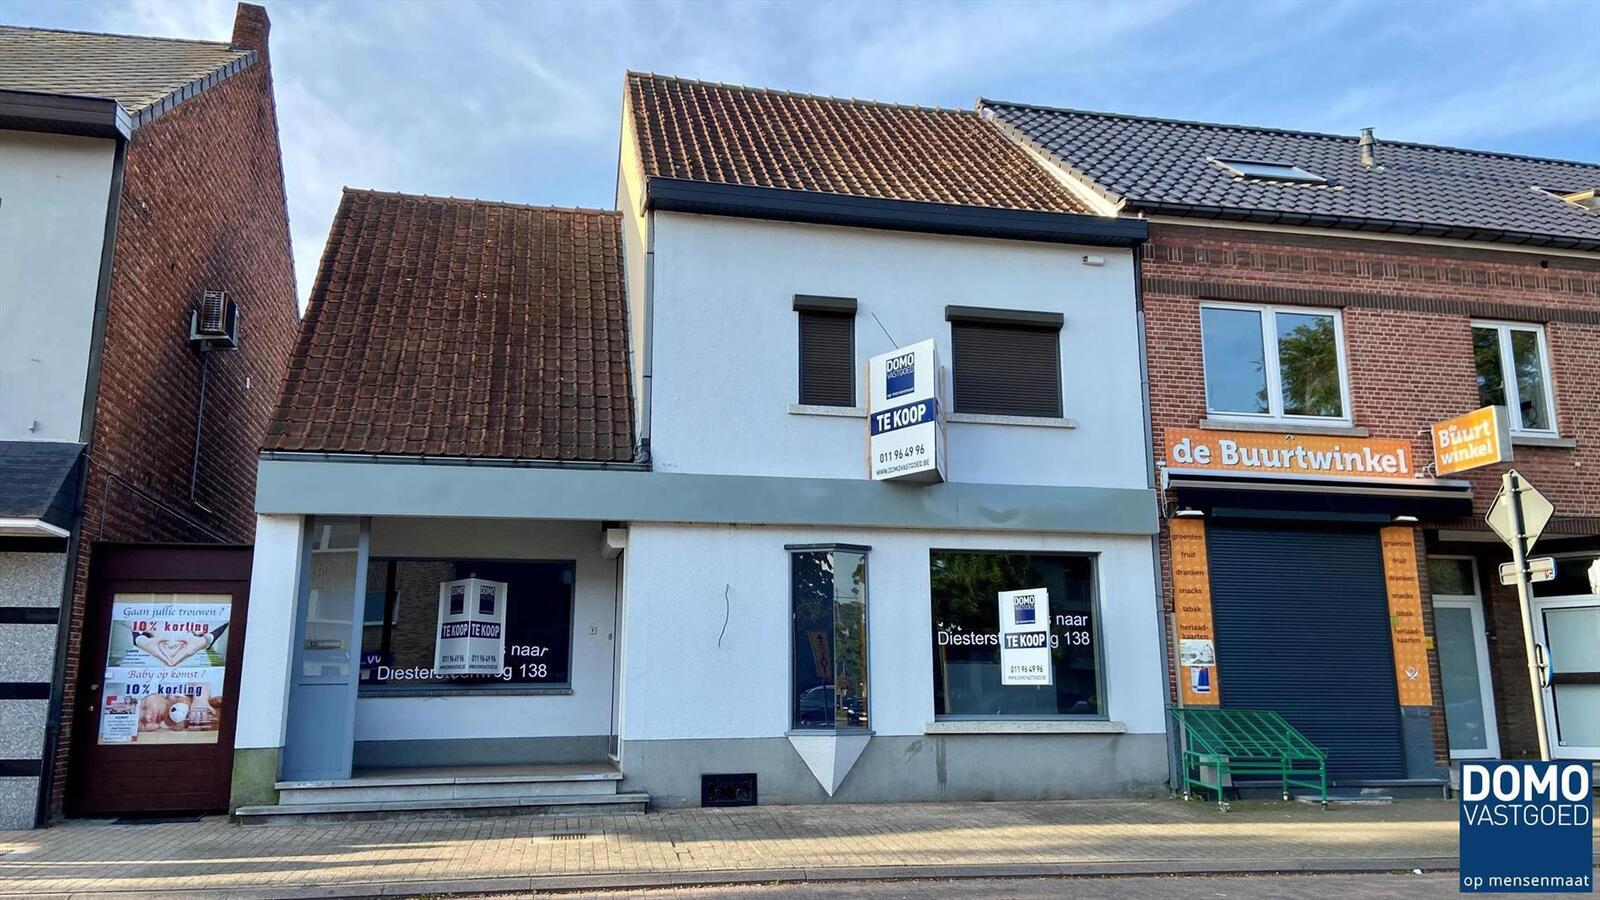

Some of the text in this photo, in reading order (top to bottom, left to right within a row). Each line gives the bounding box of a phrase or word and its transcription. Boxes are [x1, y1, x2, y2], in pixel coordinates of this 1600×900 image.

[887, 353, 914, 372] DOMO
[876, 403, 927, 431] TE KOOP
[1438, 419, 1491, 449] Buurt
[879, 444, 925, 463] 011 96 49 96
[1172, 436, 1409, 475] de Buurtwinkel
[1440, 438, 1493, 465] winkel
[1171, 533, 1203, 541] groenten
[1175, 568, 1205, 576] dranken
[1014, 595, 1035, 606] DOMO
[122, 607, 149, 619] Gaan
[151, 605, 176, 619] jullie
[178, 606, 216, 616] trouwen
[164, 621, 210, 635] korting
[1055, 615, 1089, 627] naar
[443, 624, 468, 637] TE KOOP
[471, 624, 500, 637] TE KOOP
[1005, 633, 1046, 648] TE KOOP
[1064, 631, 1091, 646] 138
[511, 645, 549, 657] naar
[128, 669, 155, 683] Baby
[156, 670, 169, 680] op
[171, 669, 198, 679] komst
[519, 663, 548, 678] 138
[1010, 665, 1020, 673] 011
[157, 684, 203, 697] korting
